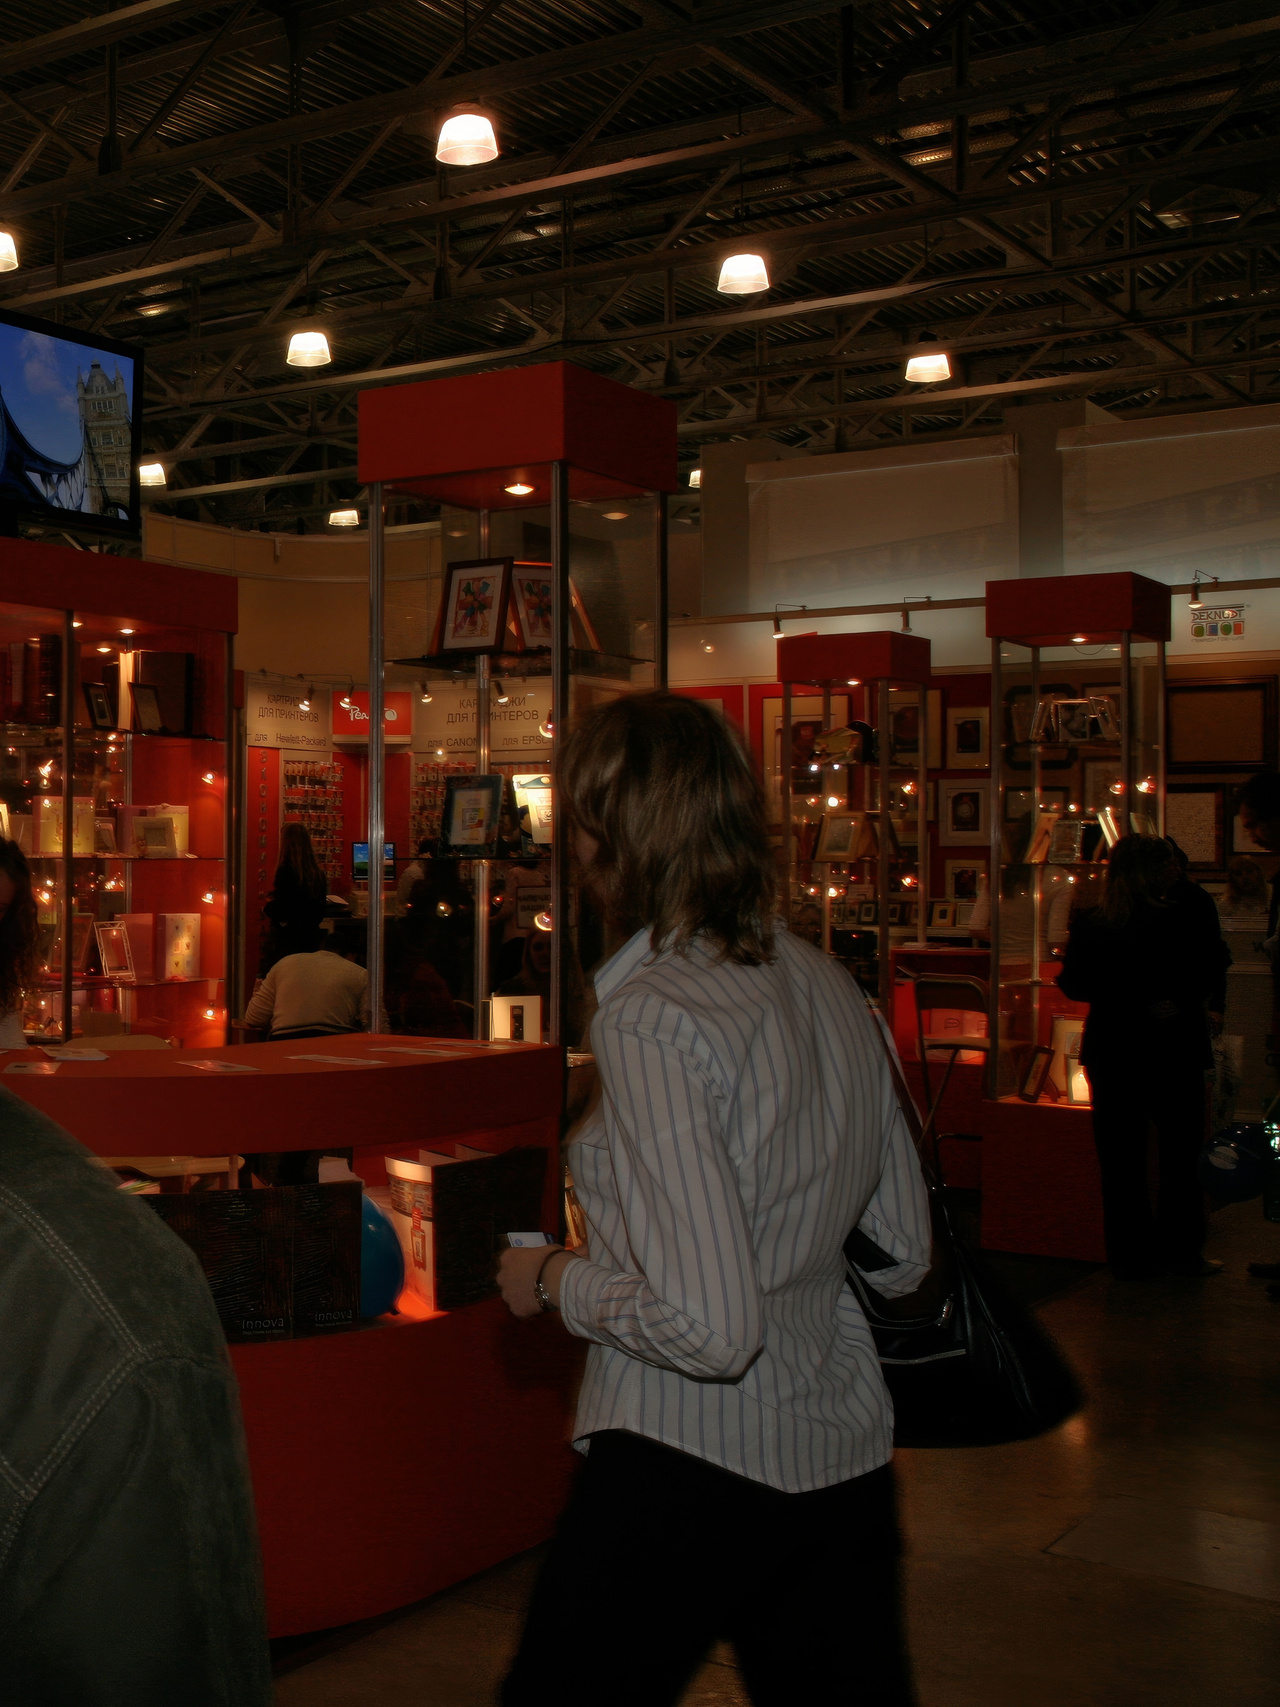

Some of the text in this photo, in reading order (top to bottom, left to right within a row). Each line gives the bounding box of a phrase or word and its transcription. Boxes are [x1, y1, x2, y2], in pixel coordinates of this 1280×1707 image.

[258, 707, 319, 722] ДЛЯ ПРИНТЕРОВ
[446, 709, 539, 724] ДЛЯ ПИНТЕРОВ
[522, 735, 552, 745] EPSO
